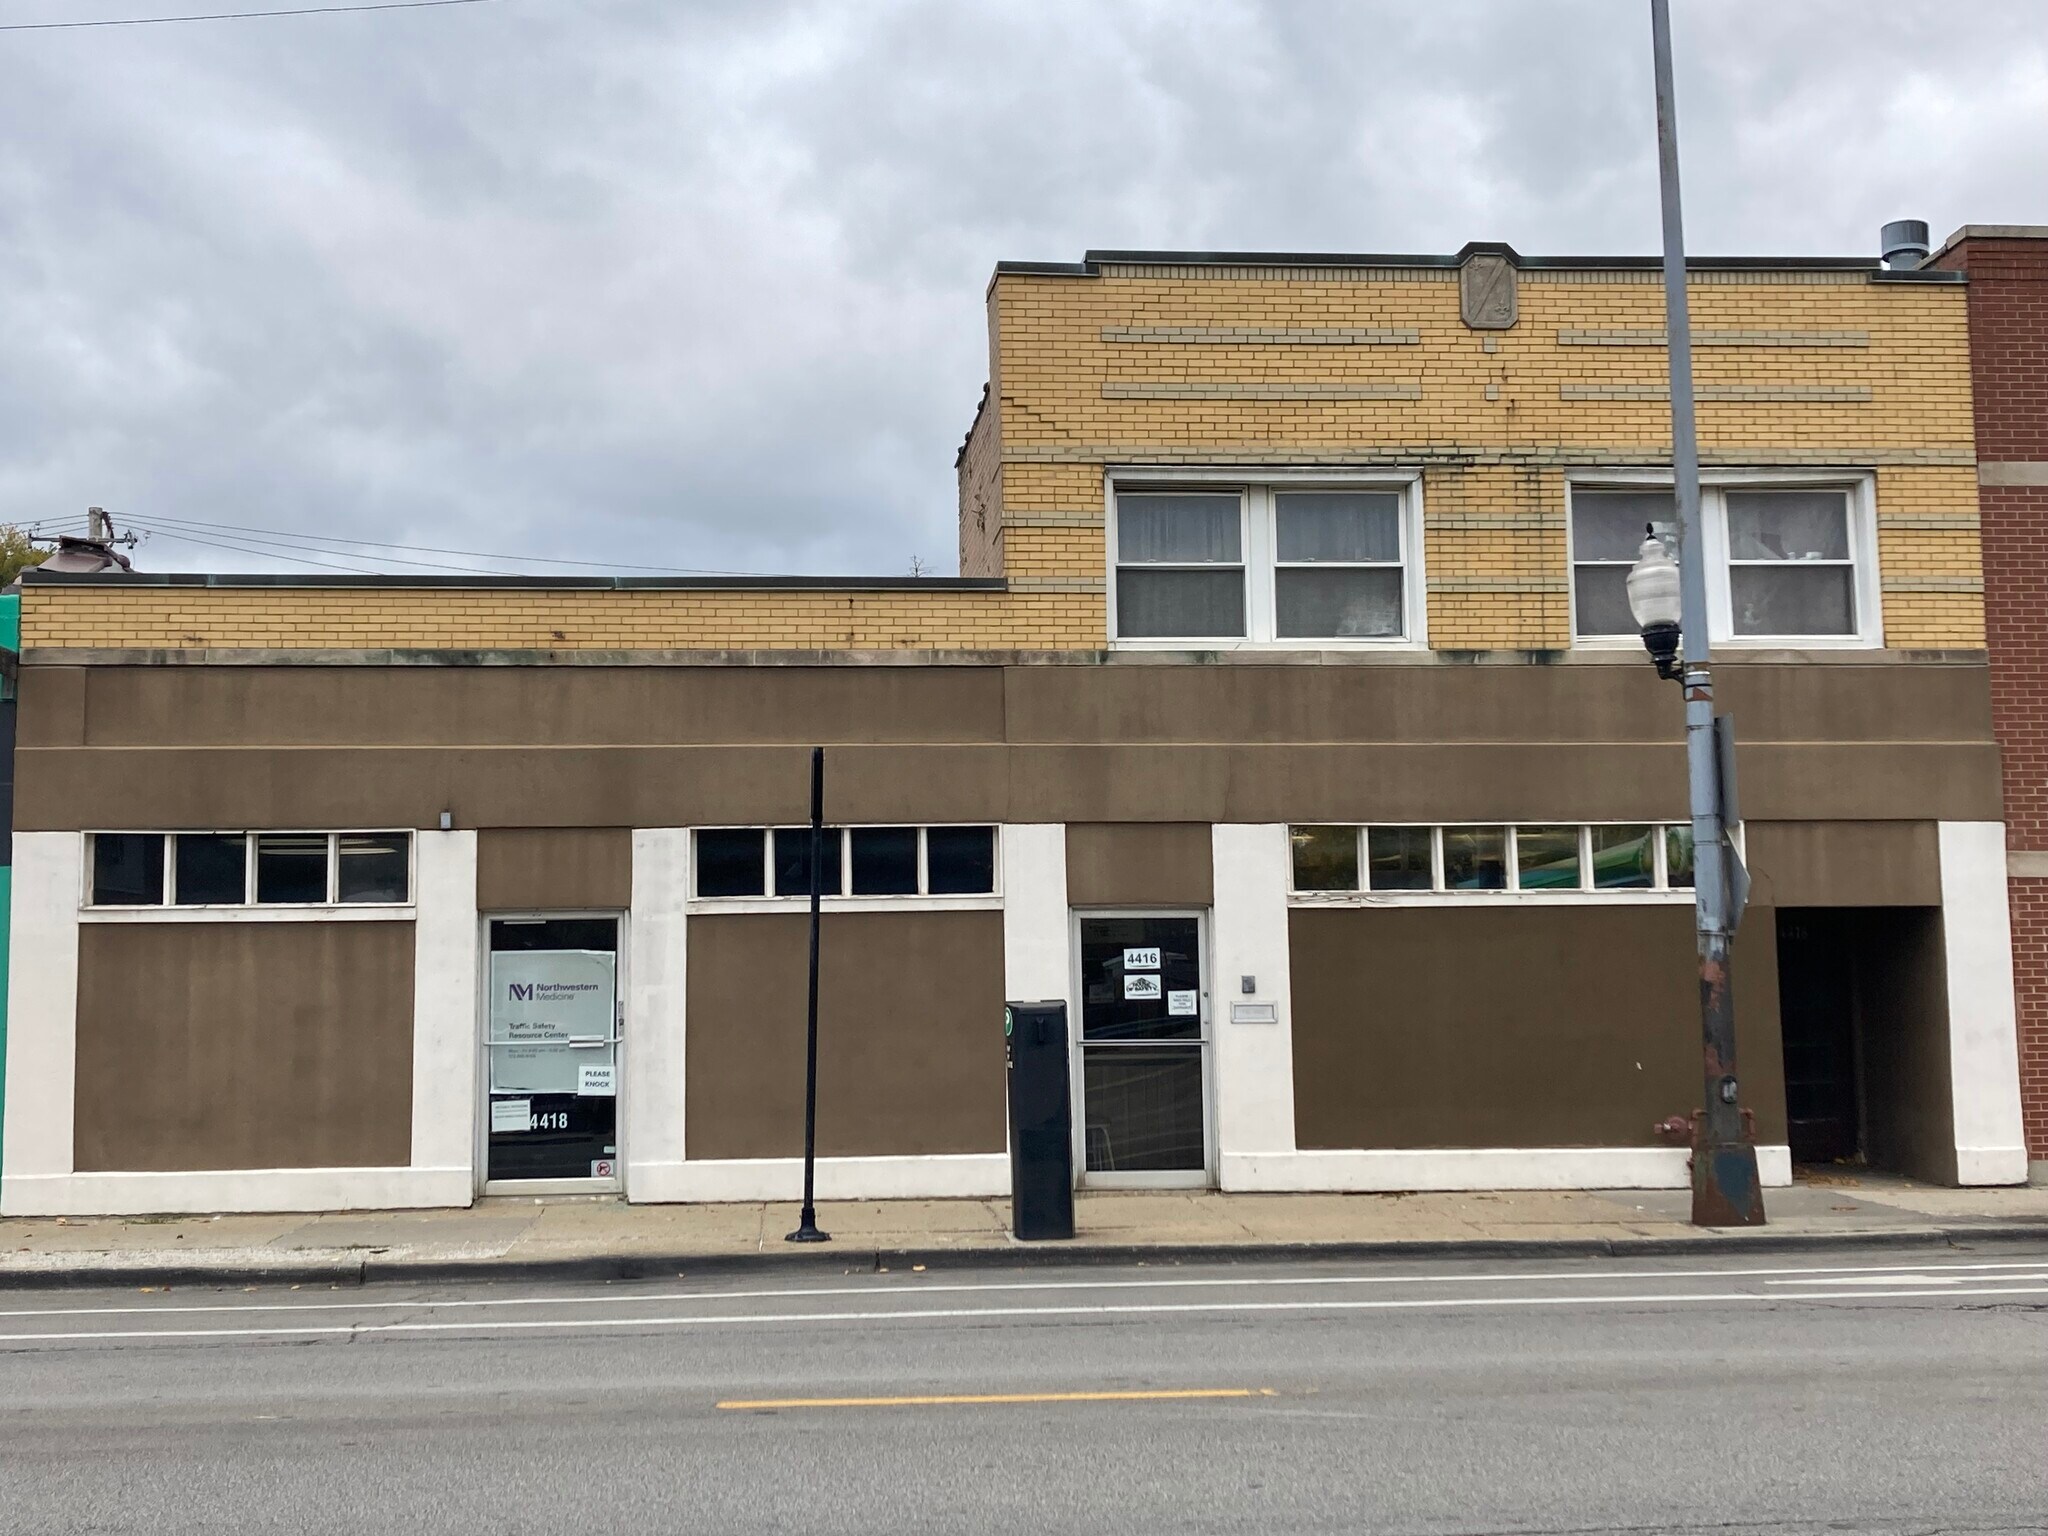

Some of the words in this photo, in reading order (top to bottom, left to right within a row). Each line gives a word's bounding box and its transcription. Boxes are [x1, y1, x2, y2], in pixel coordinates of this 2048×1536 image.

[1127, 953, 1157, 964] 4416
[536, 983, 599, 991] Northwestern
[536, 992, 576, 1001] Medicine
[530, 1113, 568, 1129] 4418
